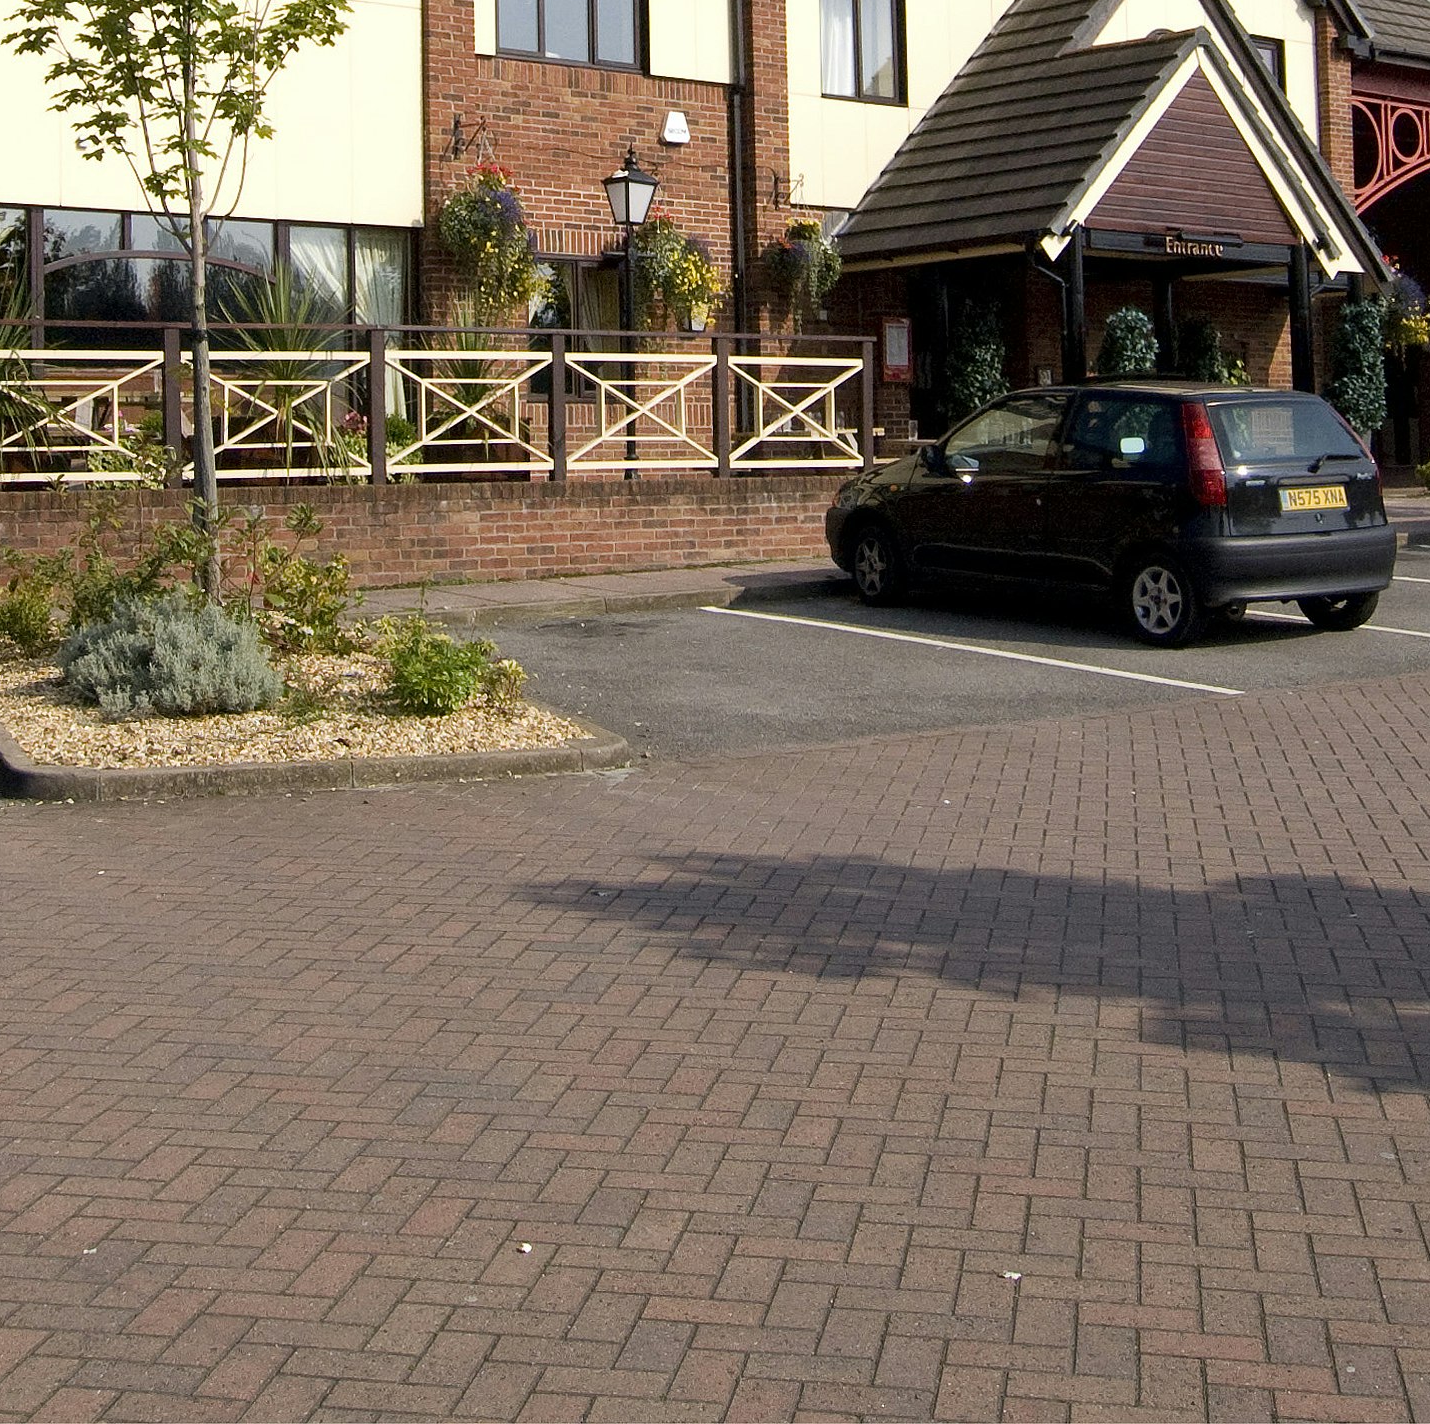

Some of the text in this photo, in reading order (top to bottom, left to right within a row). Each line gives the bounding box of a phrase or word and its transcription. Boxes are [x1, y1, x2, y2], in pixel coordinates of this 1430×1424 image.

[1165, 236, 1224, 257] Entrance
[1287, 488, 1346, 507] N575 XNA
